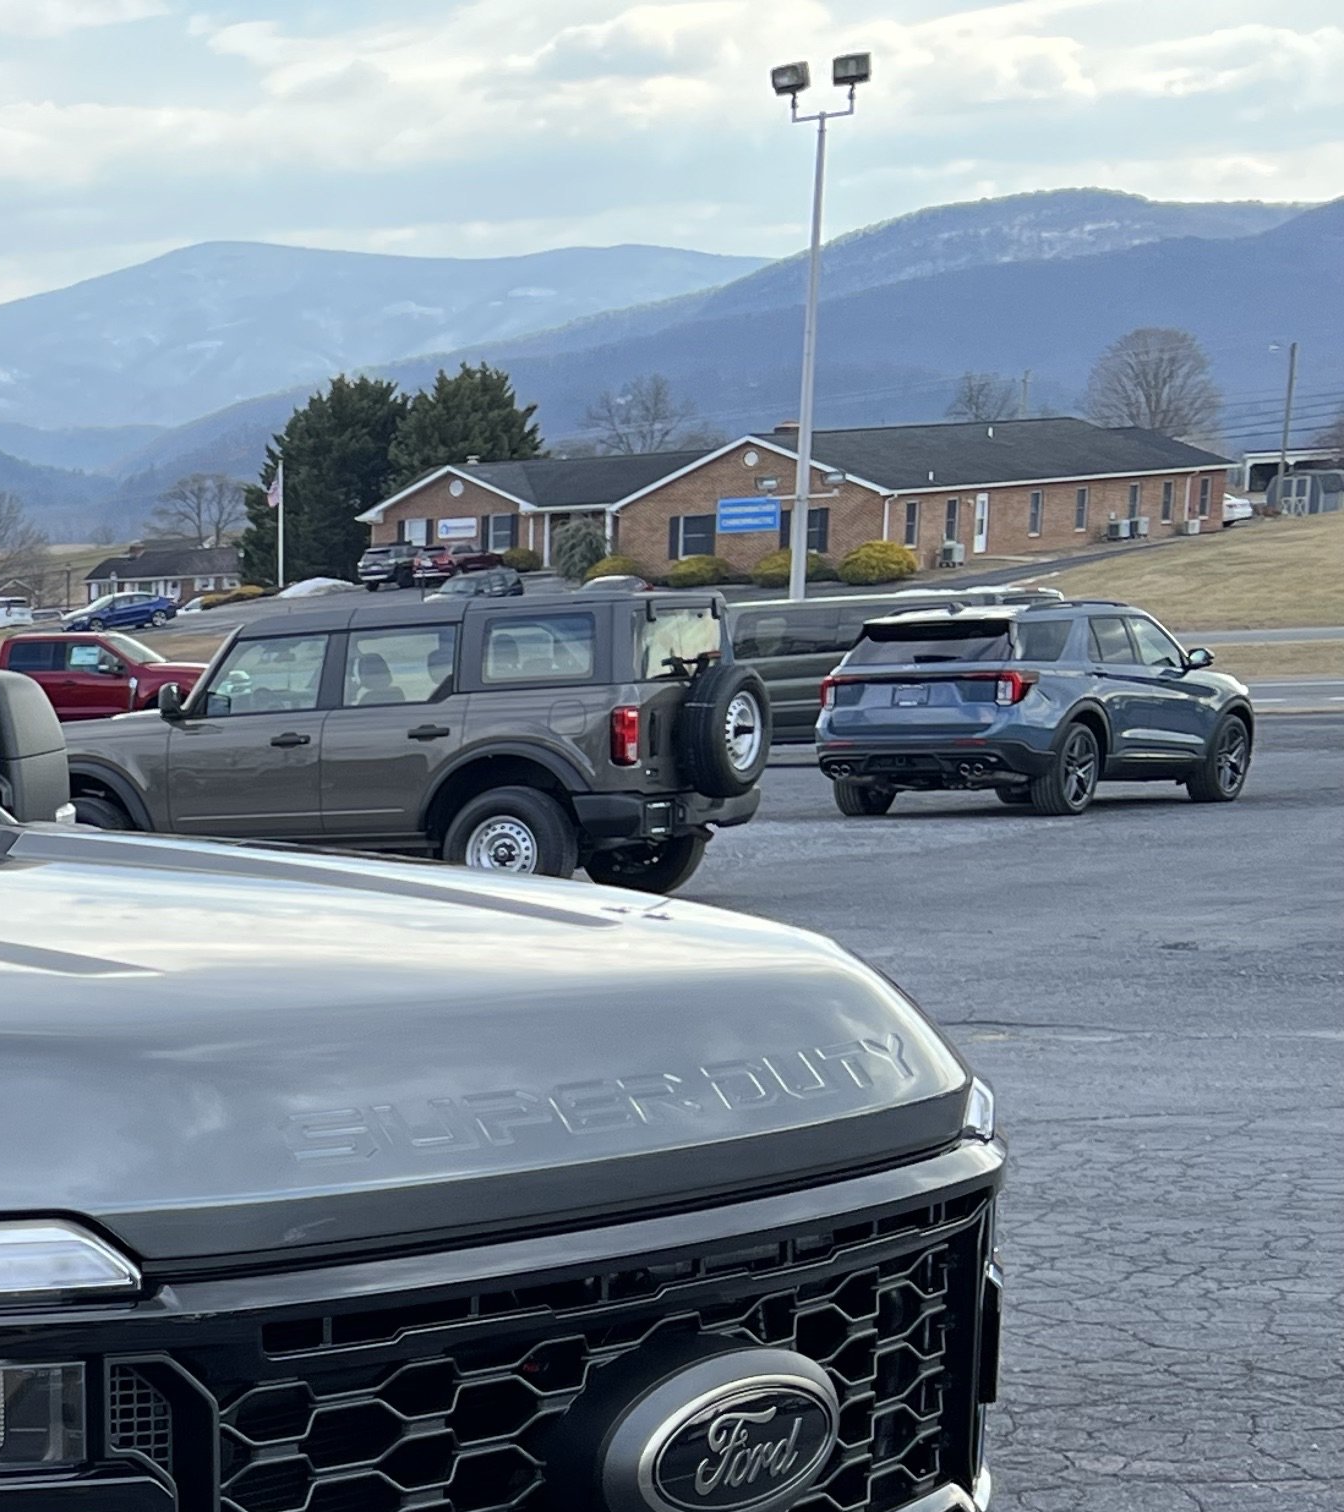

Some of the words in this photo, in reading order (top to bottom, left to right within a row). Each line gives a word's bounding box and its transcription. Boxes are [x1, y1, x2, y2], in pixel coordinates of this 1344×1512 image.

[282, 1072, 700, 1166] SUPER
[700, 1033, 915, 1110] DUTY
[695, 1406, 802, 1496] Ford
